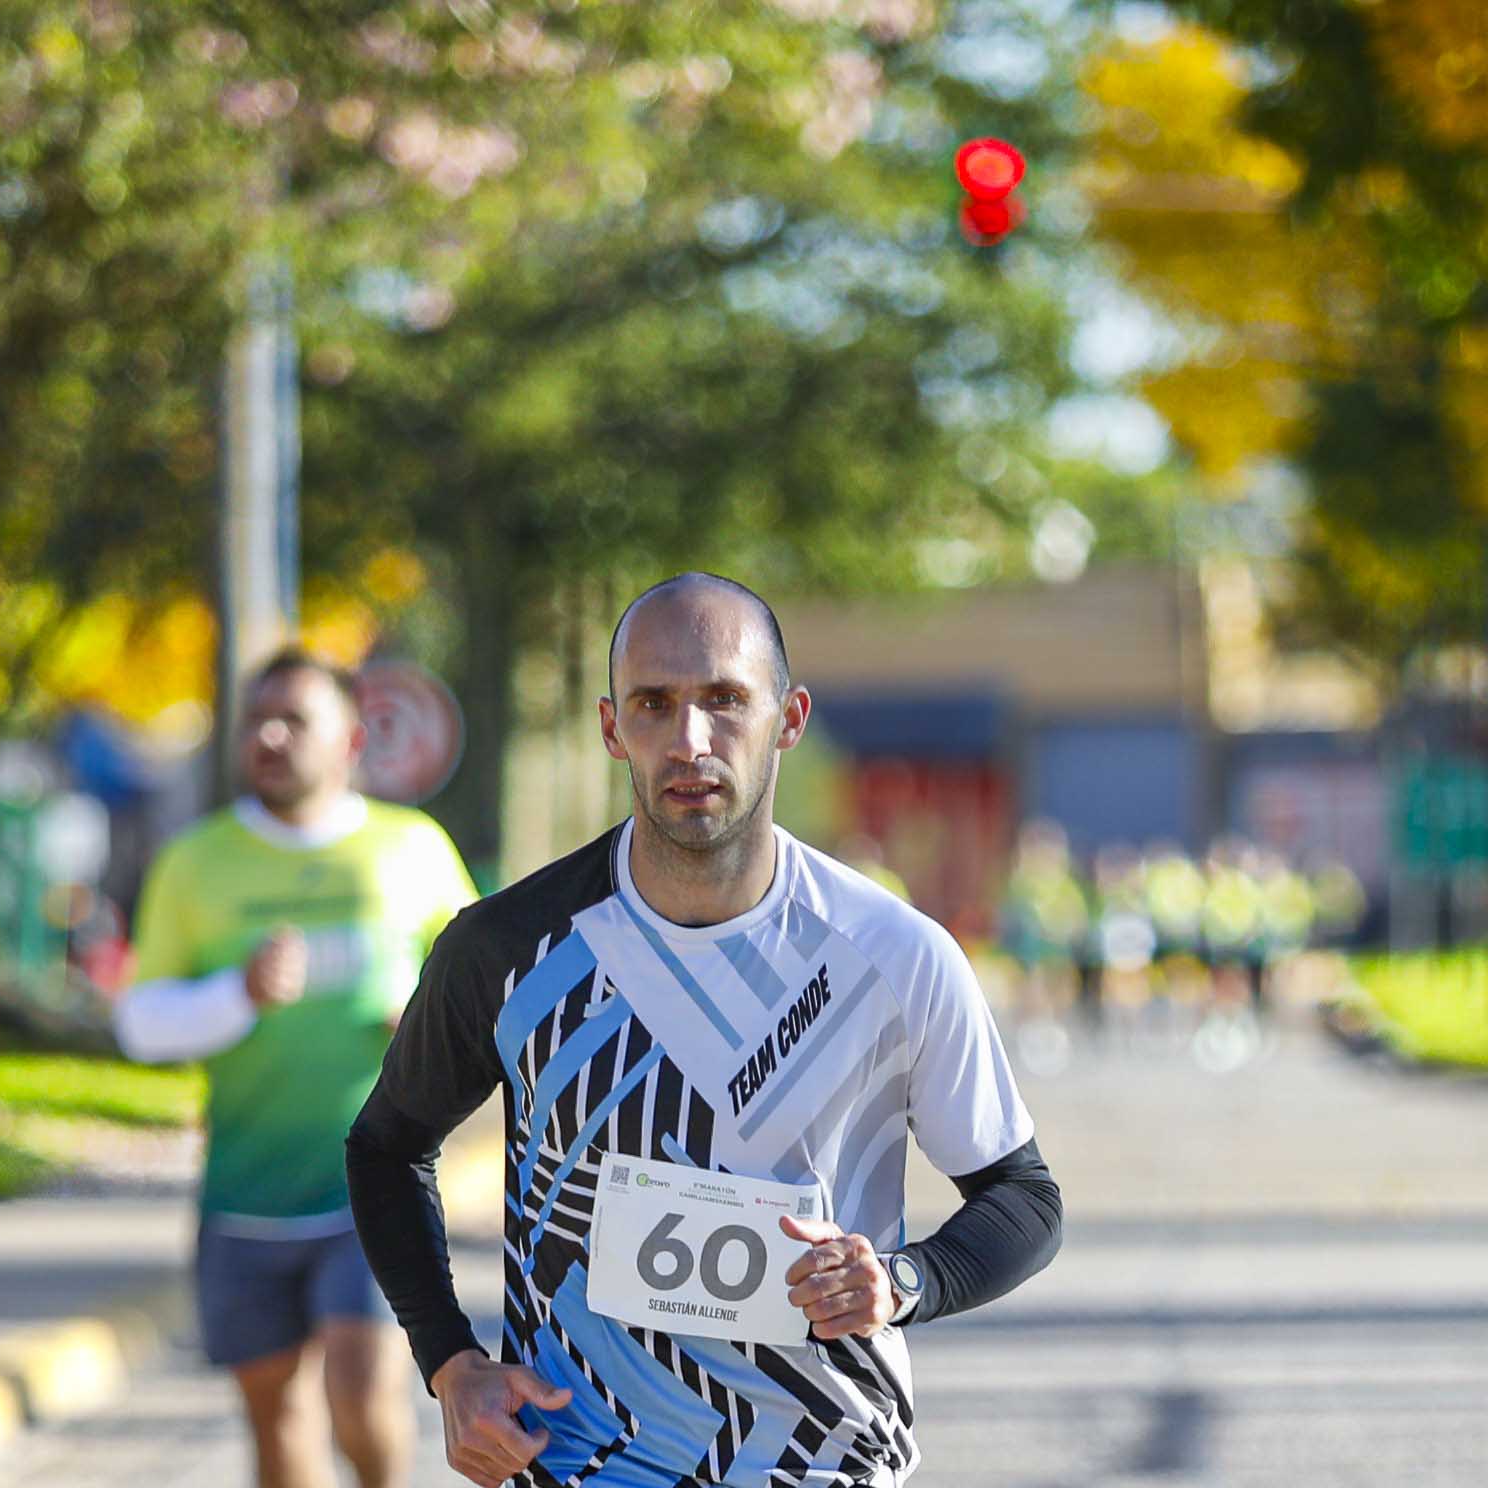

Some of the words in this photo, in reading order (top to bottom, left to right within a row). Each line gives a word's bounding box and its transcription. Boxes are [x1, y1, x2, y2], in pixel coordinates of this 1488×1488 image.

[728, 1032, 778, 1118] TEAM
[777, 962, 832, 1058] CONDE
[636, 1212, 767, 1302] 60
[648, 1298, 698, 1316] SEBASTIÁN
[698, 1305, 739, 1322] ALLENDE
